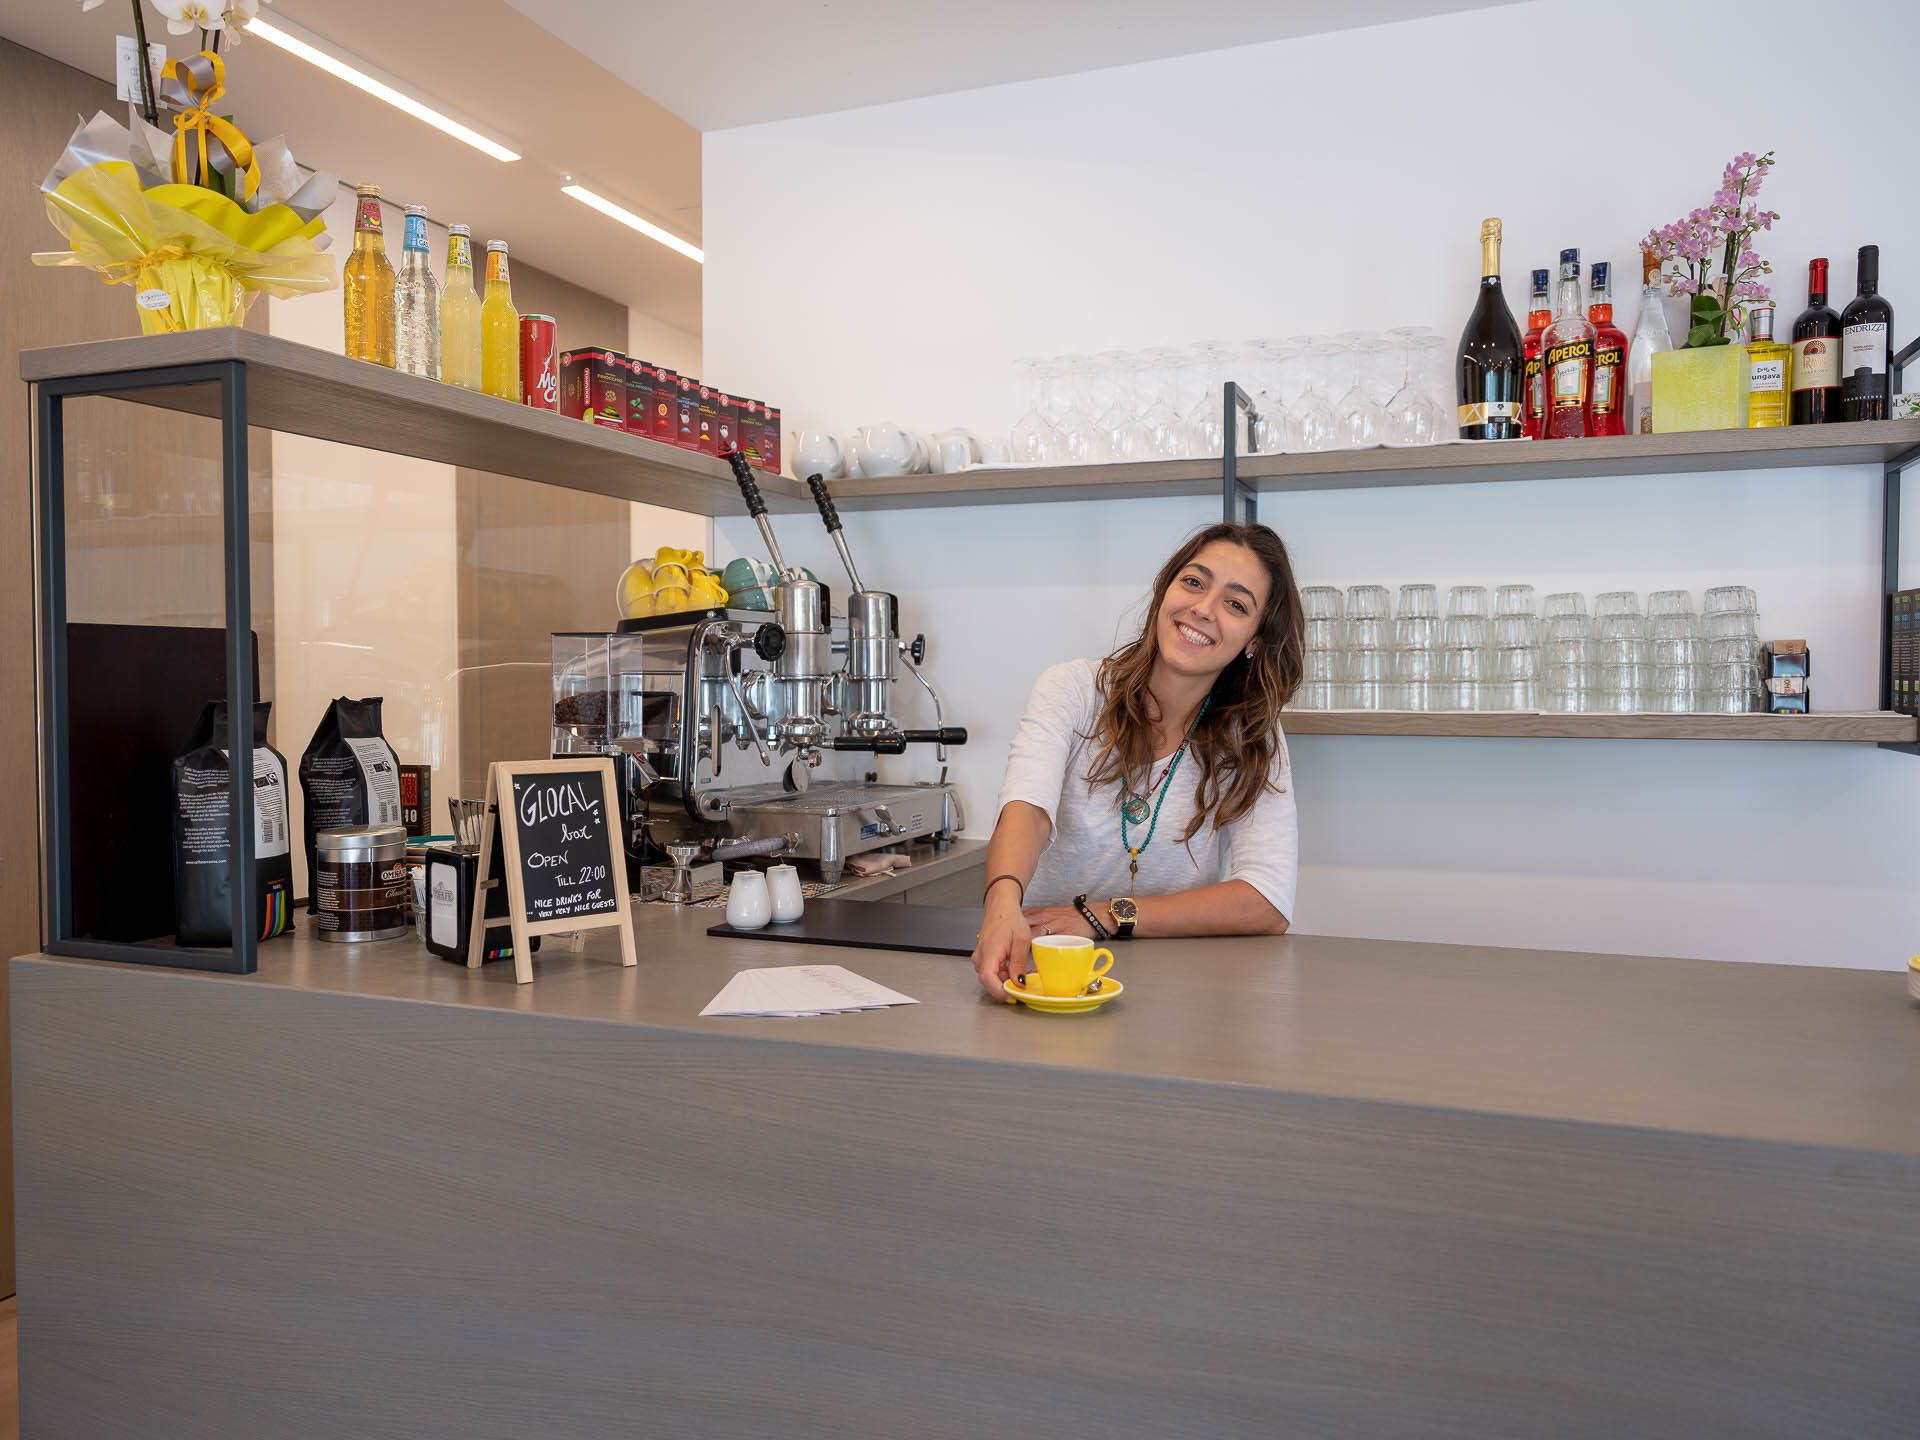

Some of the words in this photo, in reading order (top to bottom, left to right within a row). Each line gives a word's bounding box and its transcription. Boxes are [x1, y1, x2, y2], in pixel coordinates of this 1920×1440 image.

[1844, 323, 1885, 336] ENDRIZZI
[1548, 344, 1591, 365] APEROL
[1595, 351, 1620, 367] ROL
[1751, 373, 1781, 381] ungava
[520, 782, 599, 827] GLOCAL
[560, 823, 593, 844] bar
[527, 850, 569, 868] OPEN
[554, 874, 576, 887] TILL
[578, 864, 606, 885] 22:00
[534, 898, 553, 909] NICE
[555, 893, 583, 906] DRINKS
[586, 888, 602, 900] FOR
[538, 908, 553, 918] VERY
[555, 905, 571, 915] VERY
[574, 902, 590, 913] NICE
[592, 898, 615, 910] GUESTS
